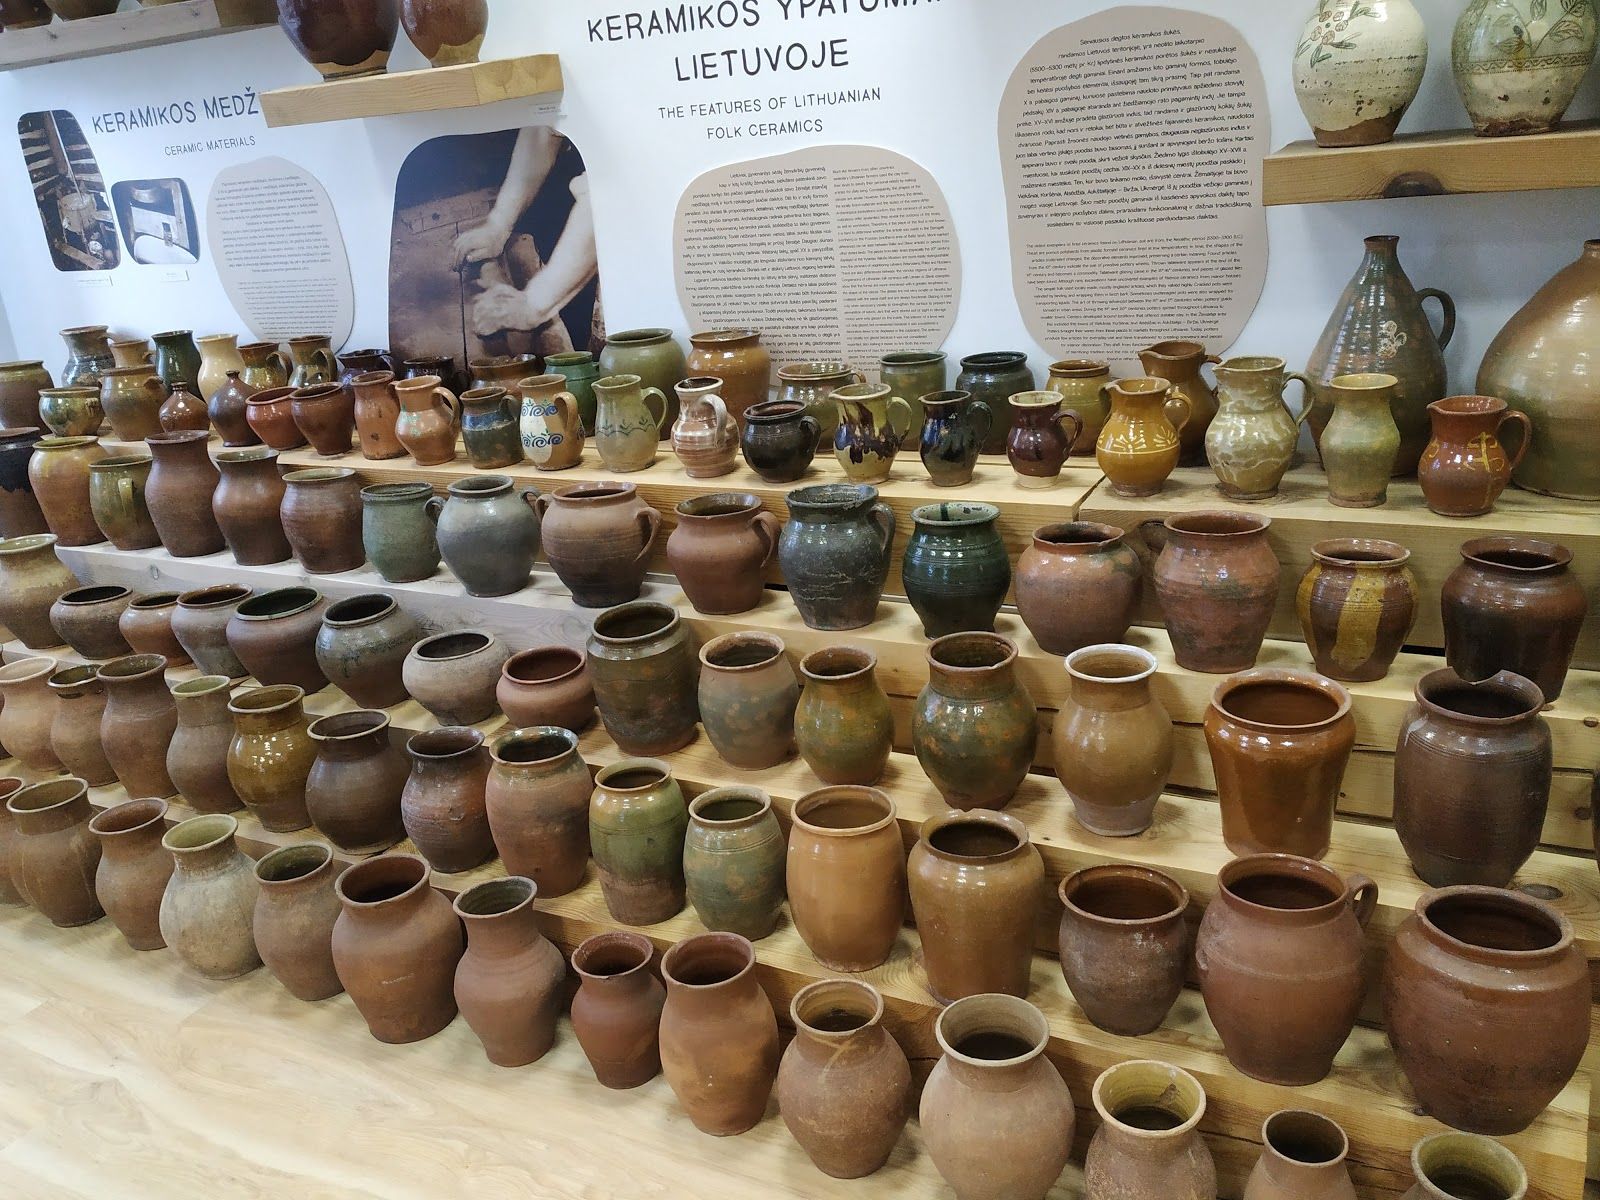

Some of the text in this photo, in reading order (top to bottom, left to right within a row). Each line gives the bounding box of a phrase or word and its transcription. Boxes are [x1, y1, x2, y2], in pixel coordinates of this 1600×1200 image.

[588, 0, 760, 42] KERAMIKOS
[1131, 30, 1161, 39] keramikos
[675, 38, 849, 82] LIETUVOJE
[1058, 49, 1085, 58] randamos
[1086, 46, 1110, 55] Lietuvos
[1124, 53, 1153, 62] keramikos
[1213, 67, 1240, 76] randama
[1227, 89, 1245, 99] tampa
[658, 87, 881, 120] THE FEATURES OF LITHUANIAN
[1153, 106, 1178, 114] randama
[92, 101, 197, 134] KERAMIKOS
[706, 118, 823, 140] FOLK CERAMICS
[165, 136, 256, 156] CERAMIC MATERIALS
